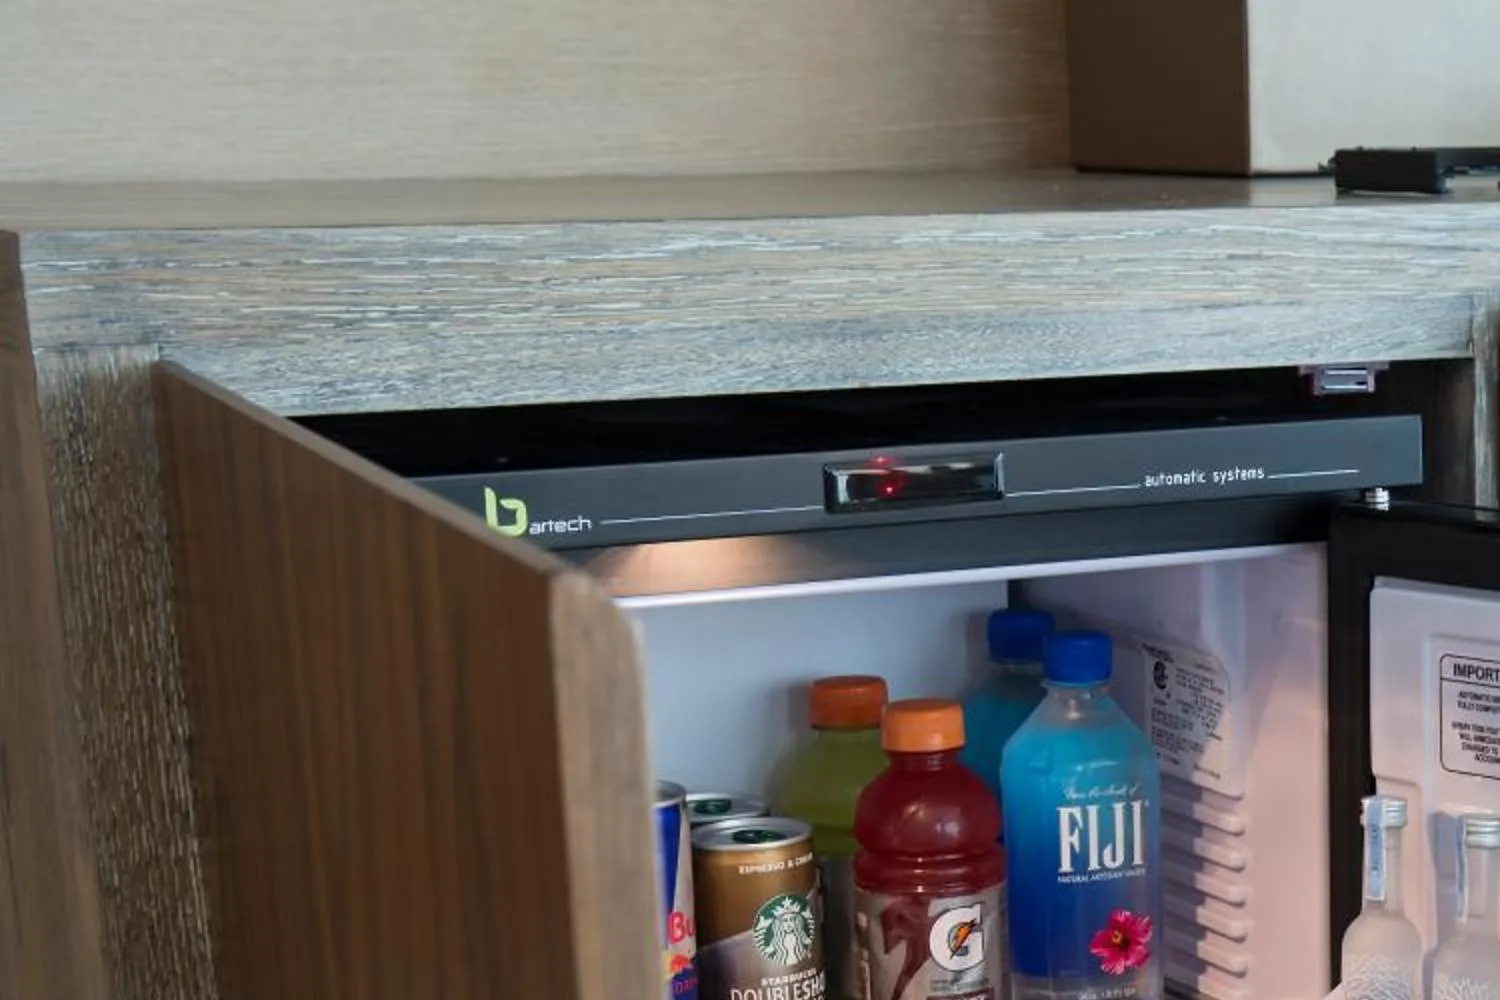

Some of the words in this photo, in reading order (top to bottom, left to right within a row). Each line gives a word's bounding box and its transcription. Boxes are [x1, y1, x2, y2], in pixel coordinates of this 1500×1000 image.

[1145, 469, 1206, 487] automatic
[1213, 466, 1264, 485] systems
[1056, 799, 1144, 873] FIJI
[668, 911, 696, 944] Bu
